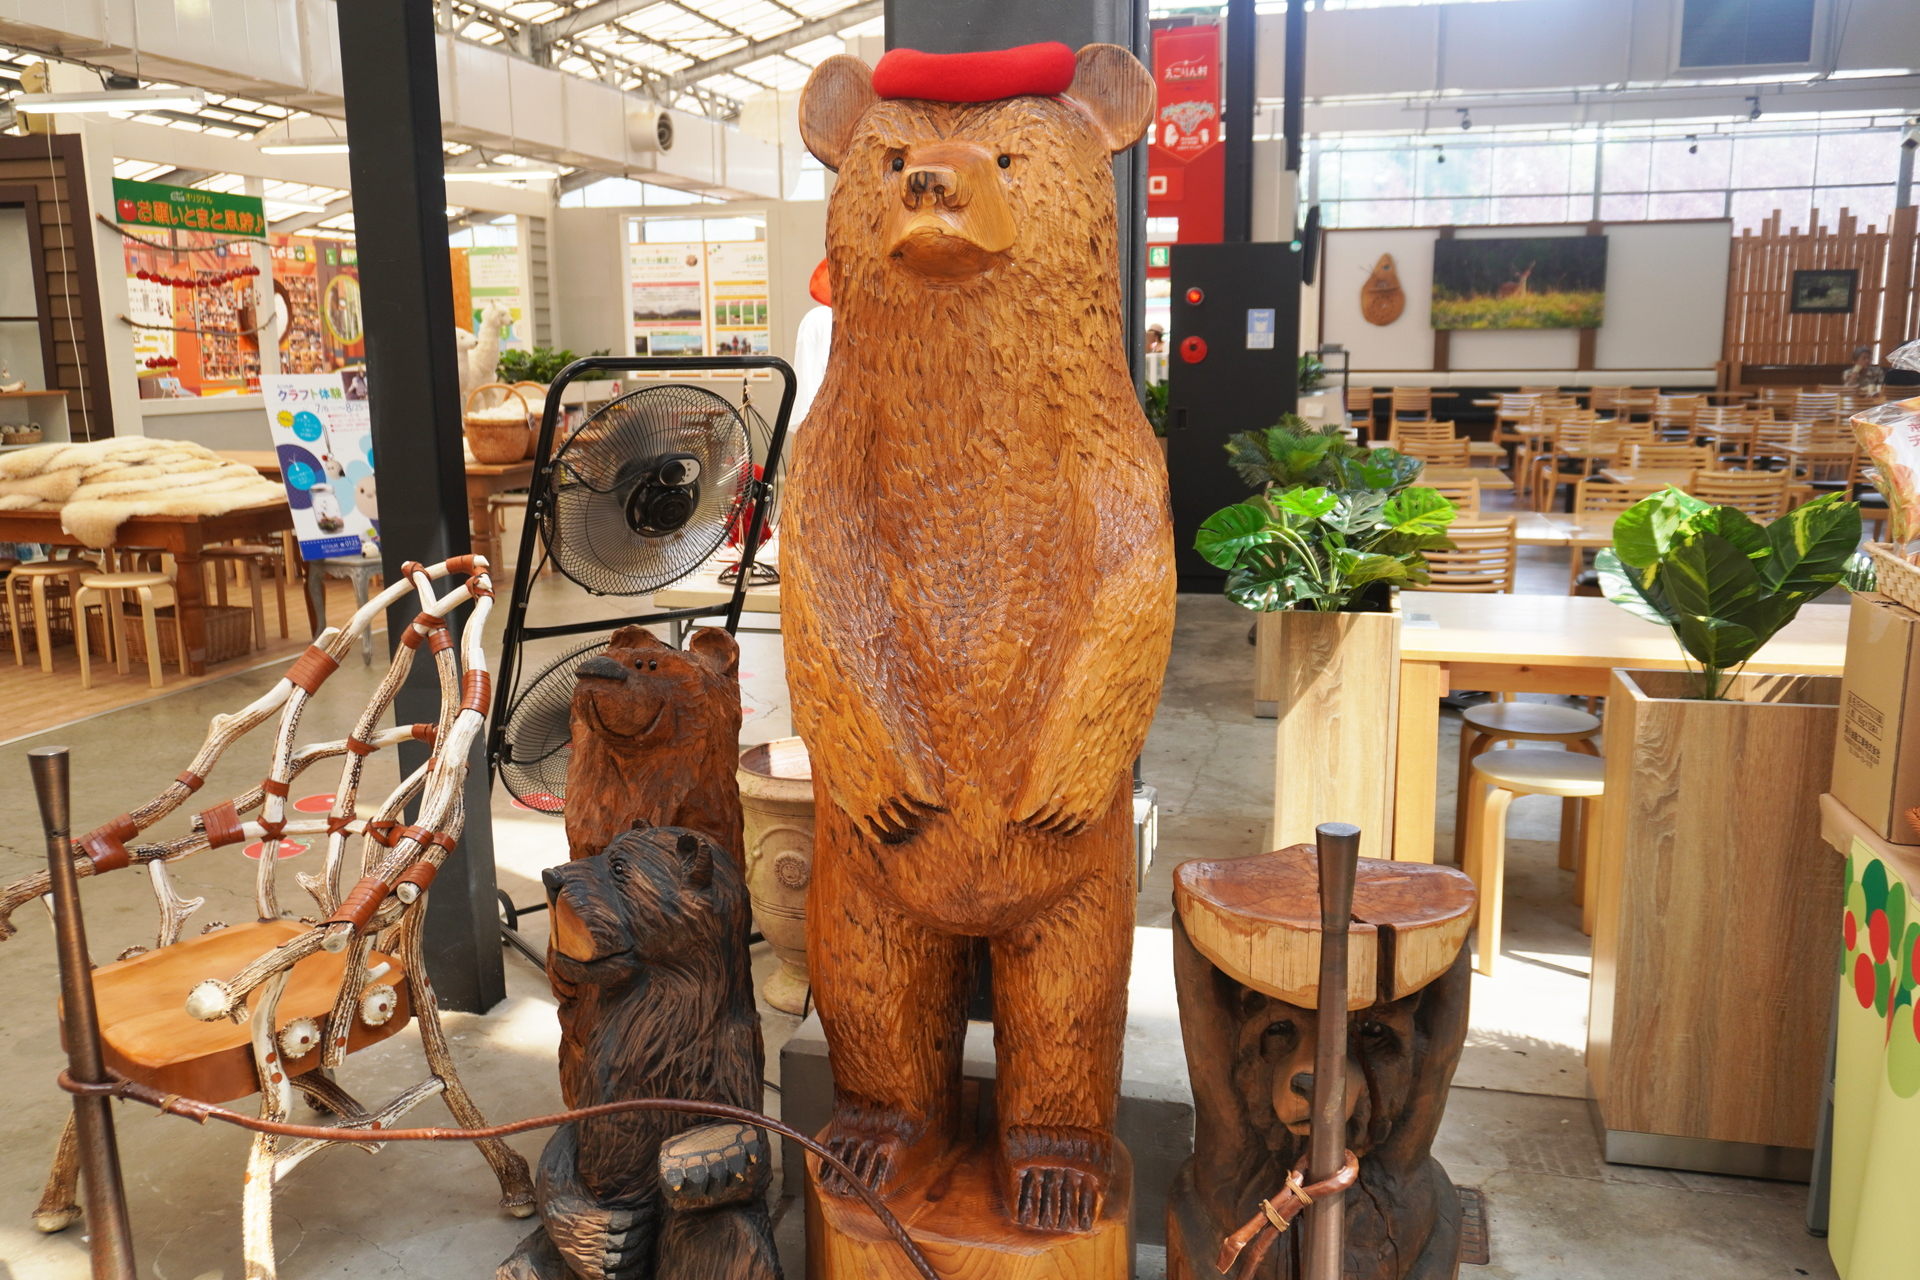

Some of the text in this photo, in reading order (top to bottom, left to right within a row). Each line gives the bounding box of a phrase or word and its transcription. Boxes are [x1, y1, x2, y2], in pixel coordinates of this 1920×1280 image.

[277, 386, 343, 402] クラフト体験
